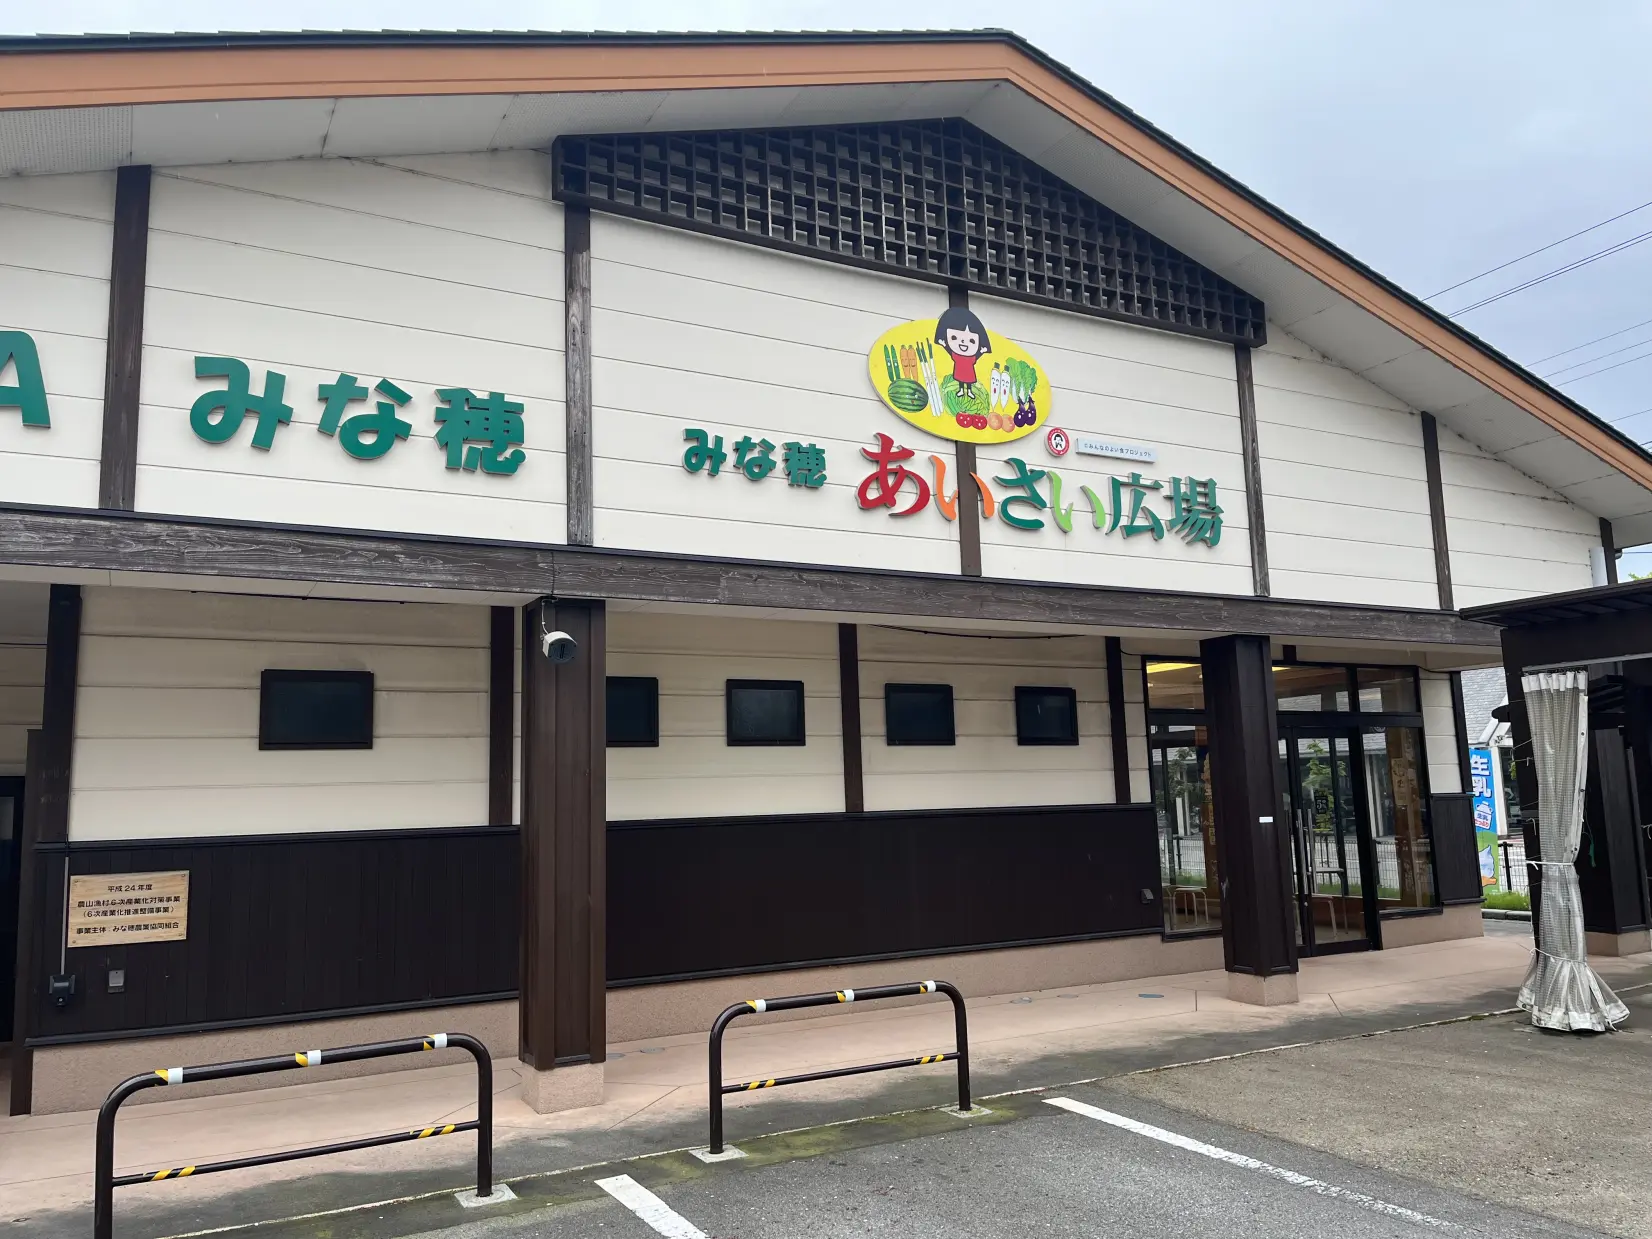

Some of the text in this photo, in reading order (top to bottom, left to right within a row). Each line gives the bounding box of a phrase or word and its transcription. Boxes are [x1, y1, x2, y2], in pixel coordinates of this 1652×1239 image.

[190, 355, 526, 475] みな穂
[683, 427, 1225, 547] みな穂 あいさい広場
[1470, 754, 1492, 798] 生乳
